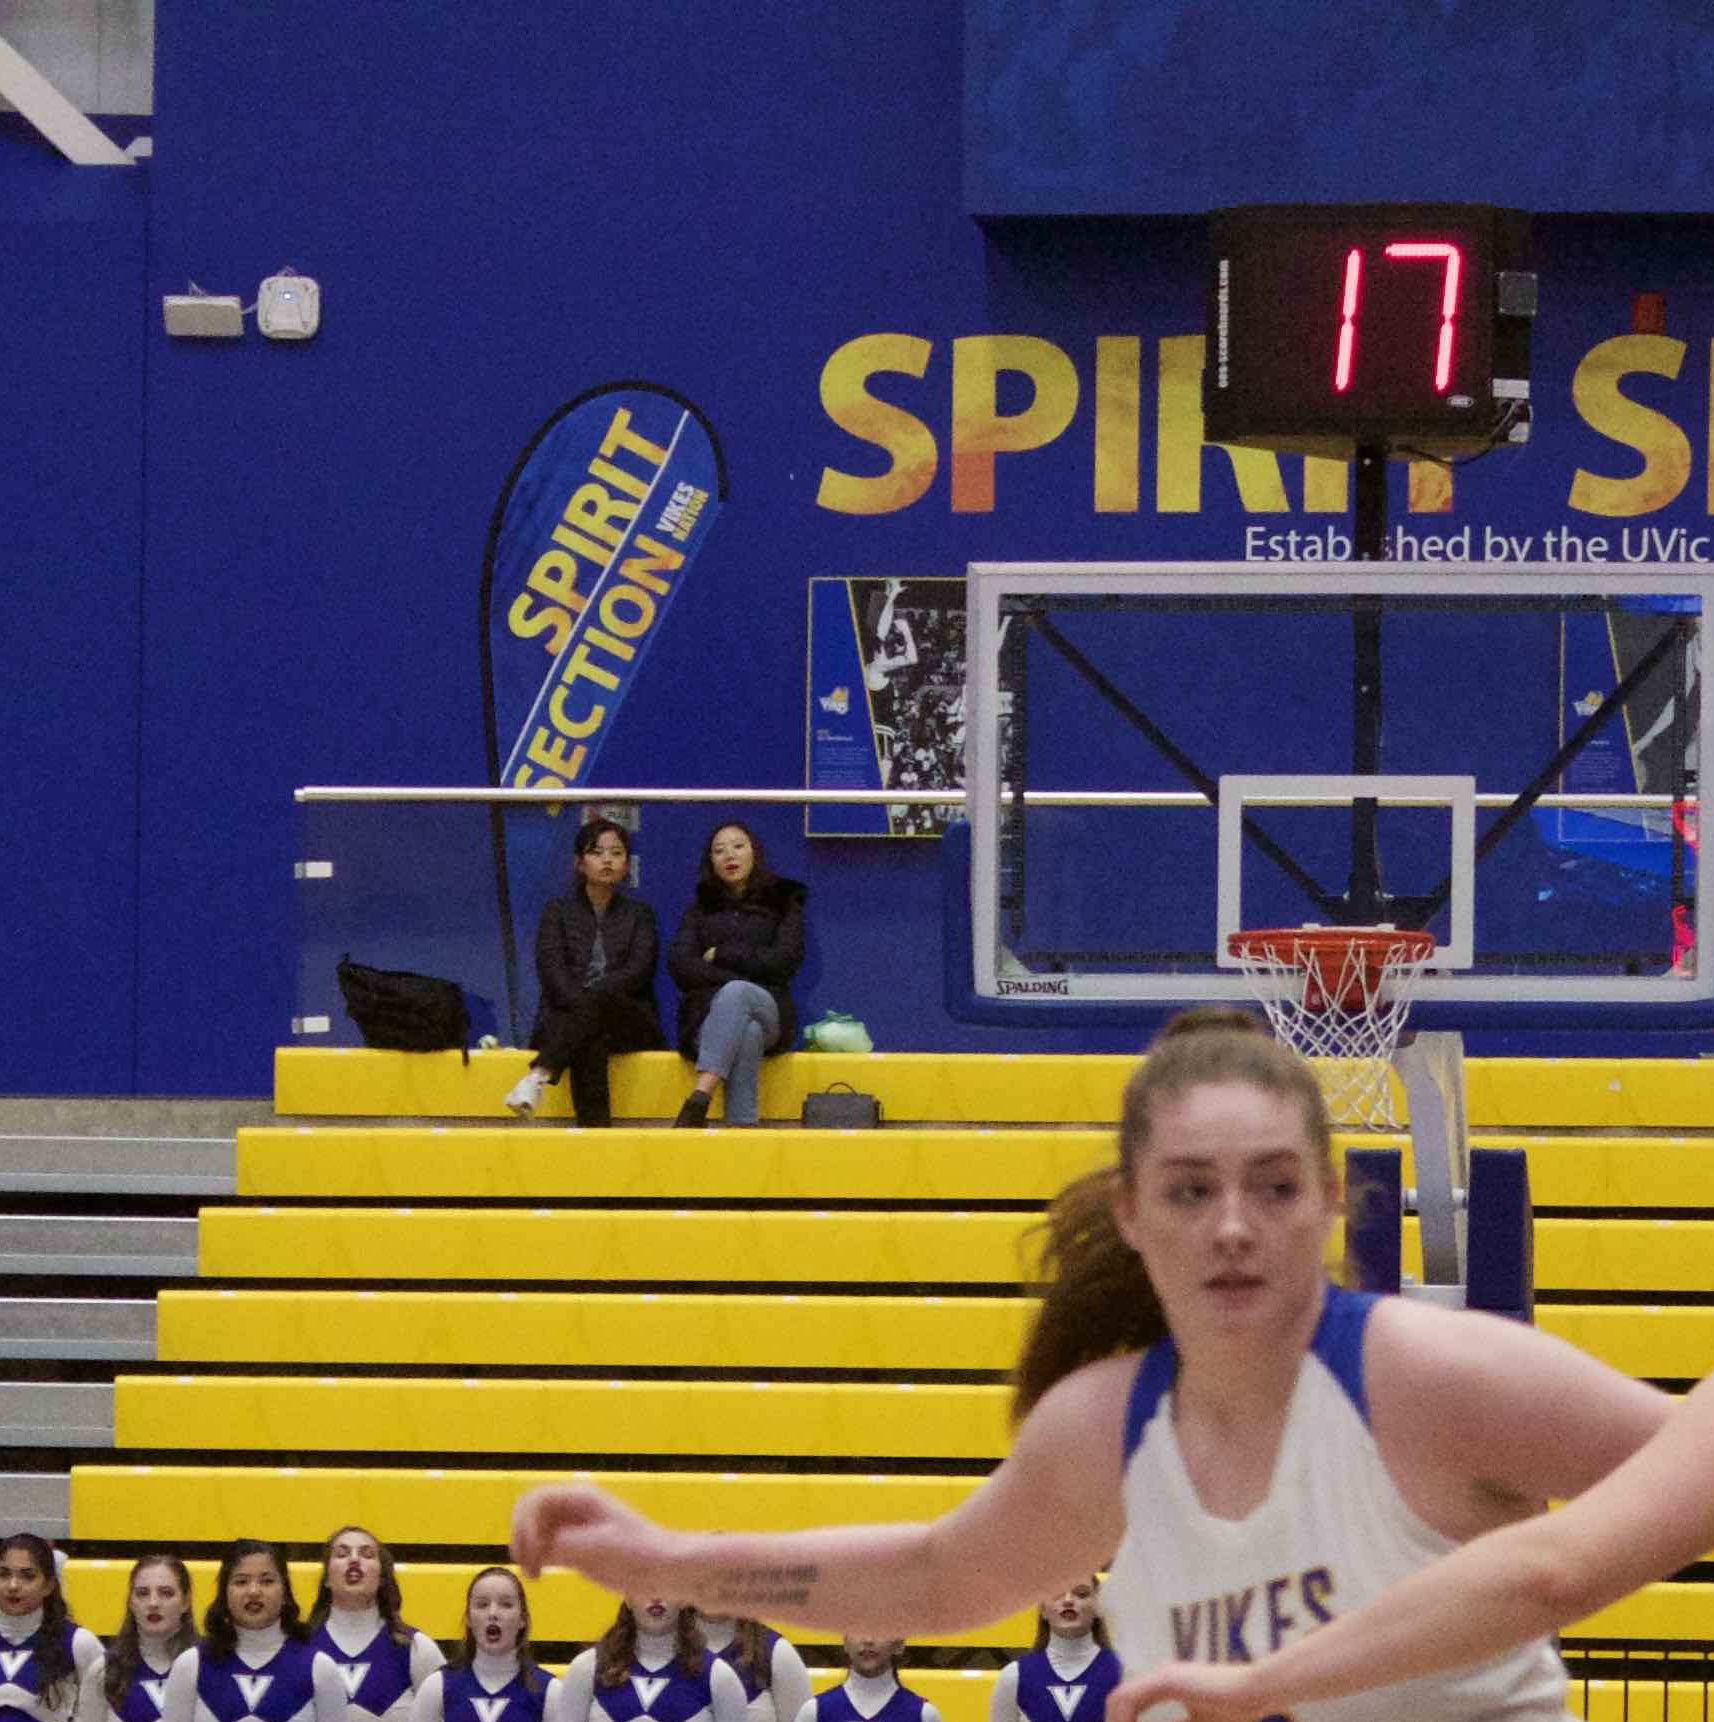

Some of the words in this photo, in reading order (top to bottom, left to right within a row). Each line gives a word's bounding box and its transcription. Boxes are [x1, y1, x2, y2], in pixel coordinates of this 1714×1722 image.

[1334, 242, 1463, 392] 17
[816, 333, 1454, 515] SPIR
[508, 408, 671, 657] SPIRIT
[1245, 525, 1469, 562] Estabhed
[1542, 525, 1608, 562] the
[1622, 526, 1710, 563] UVic
[514, 534, 686, 816] SECTION
[996, 980, 1070, 996] SPALDING
[1169, 1565, 1338, 1664] VIKES
